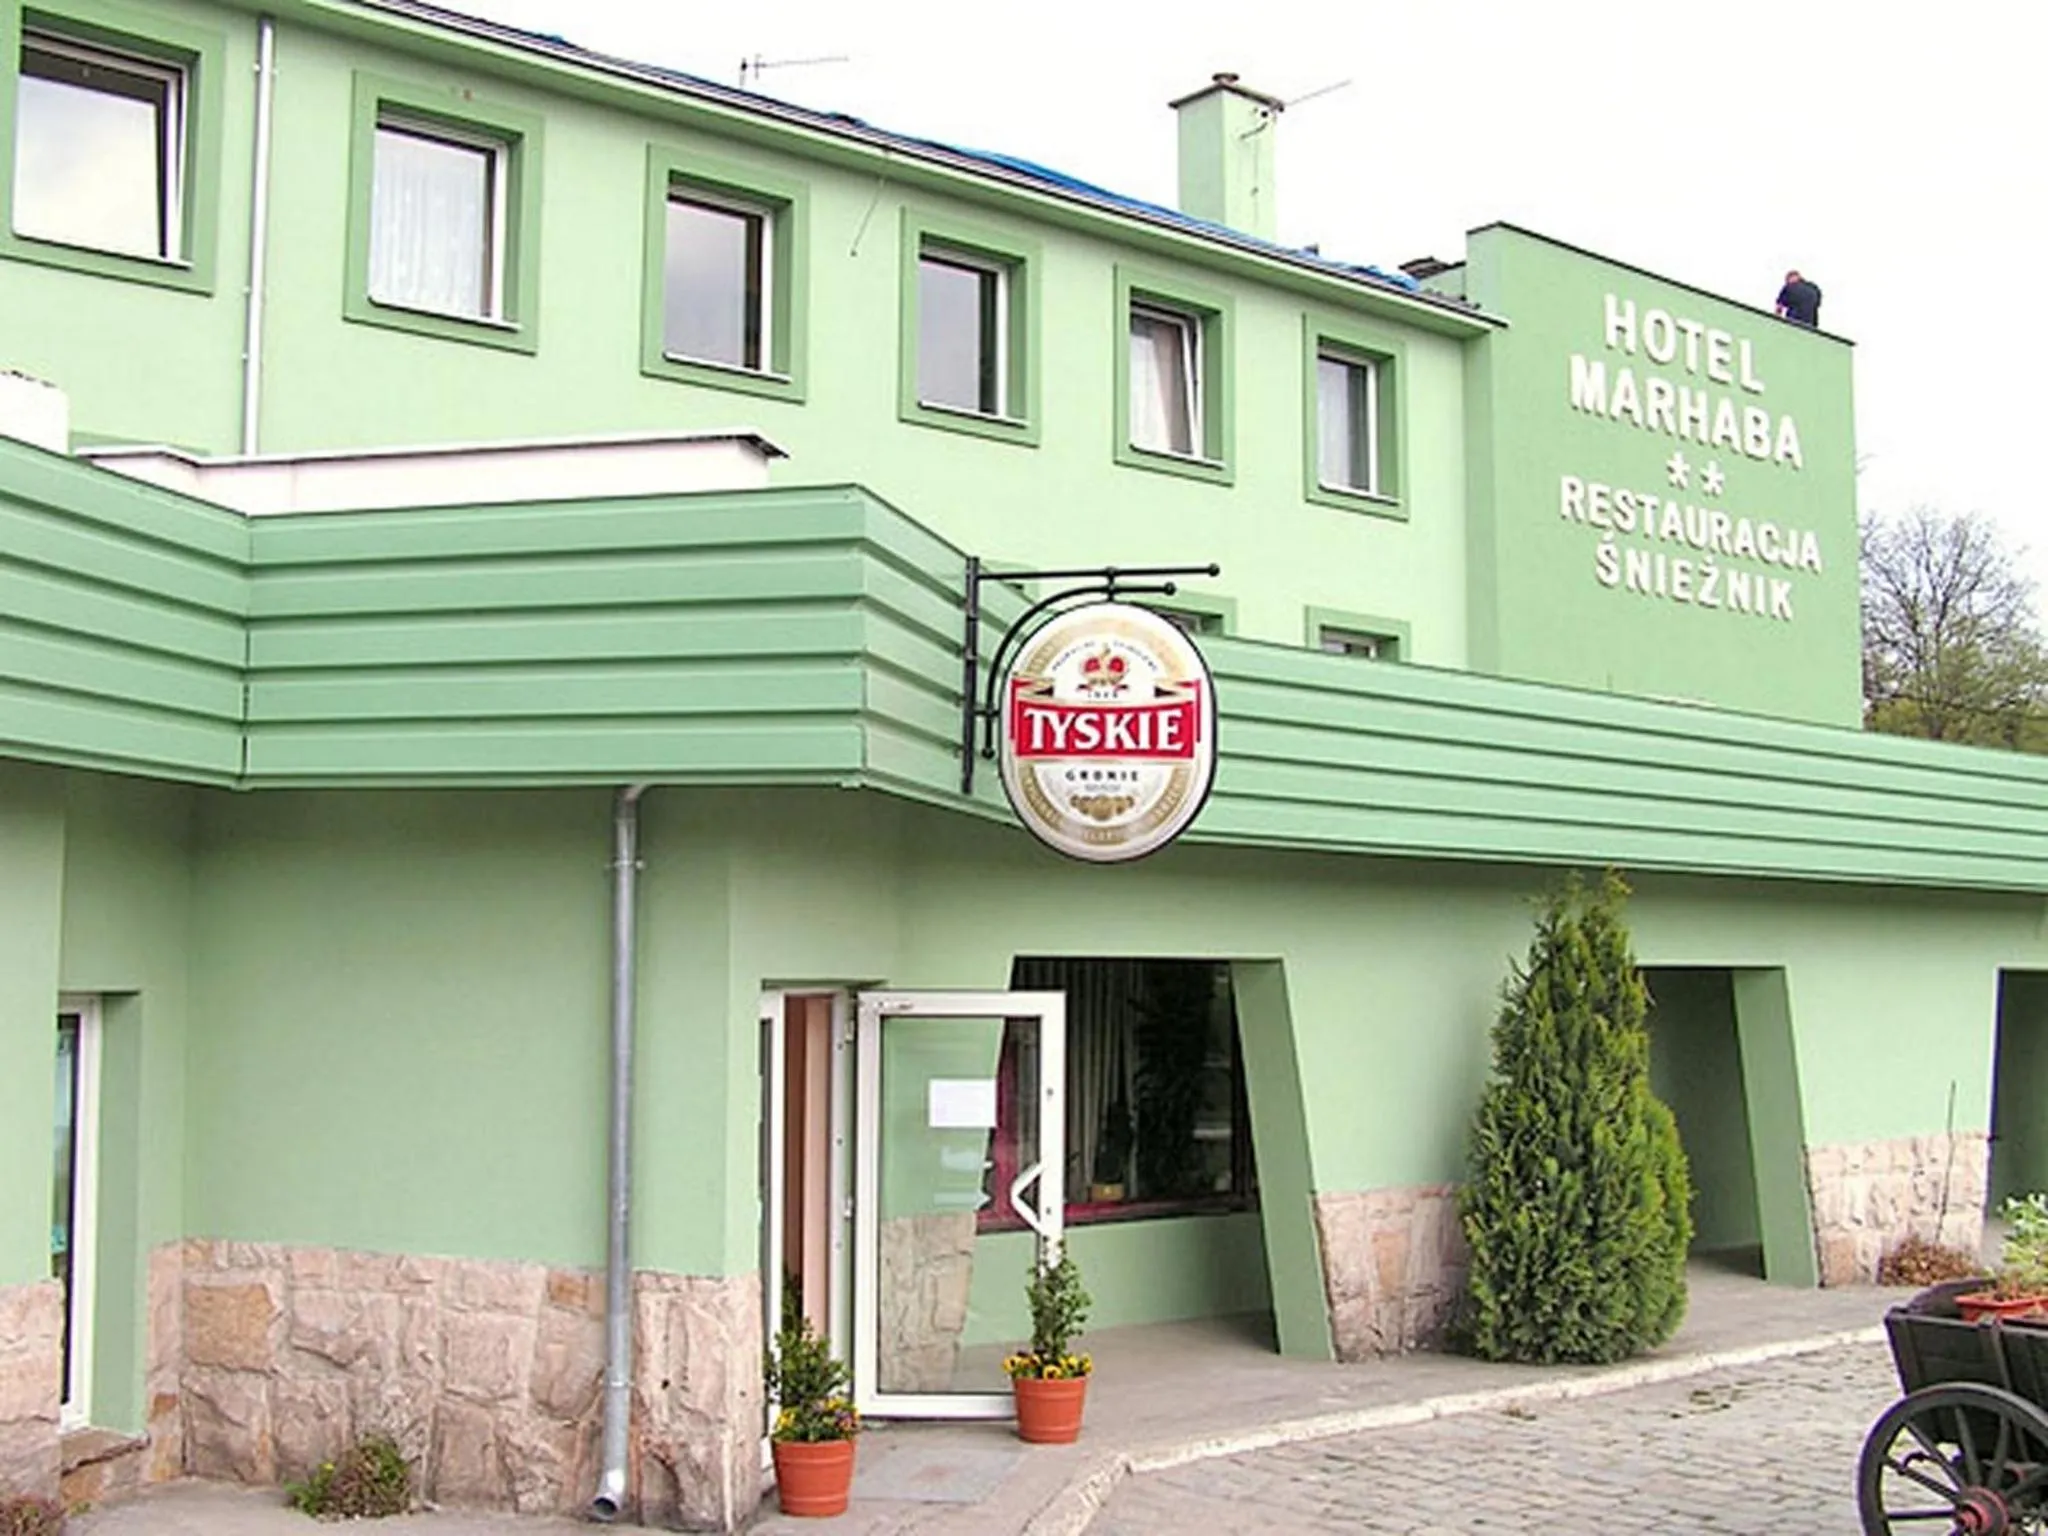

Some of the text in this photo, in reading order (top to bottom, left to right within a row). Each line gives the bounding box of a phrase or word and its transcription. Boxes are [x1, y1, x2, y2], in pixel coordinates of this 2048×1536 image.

[1604, 294, 1763, 394] HOTEL
[1570, 354, 1803, 470] MARHABA
[1560, 475, 1822, 575] RESTAURACJA
[1024, 708, 1185, 751] TYSKIE
